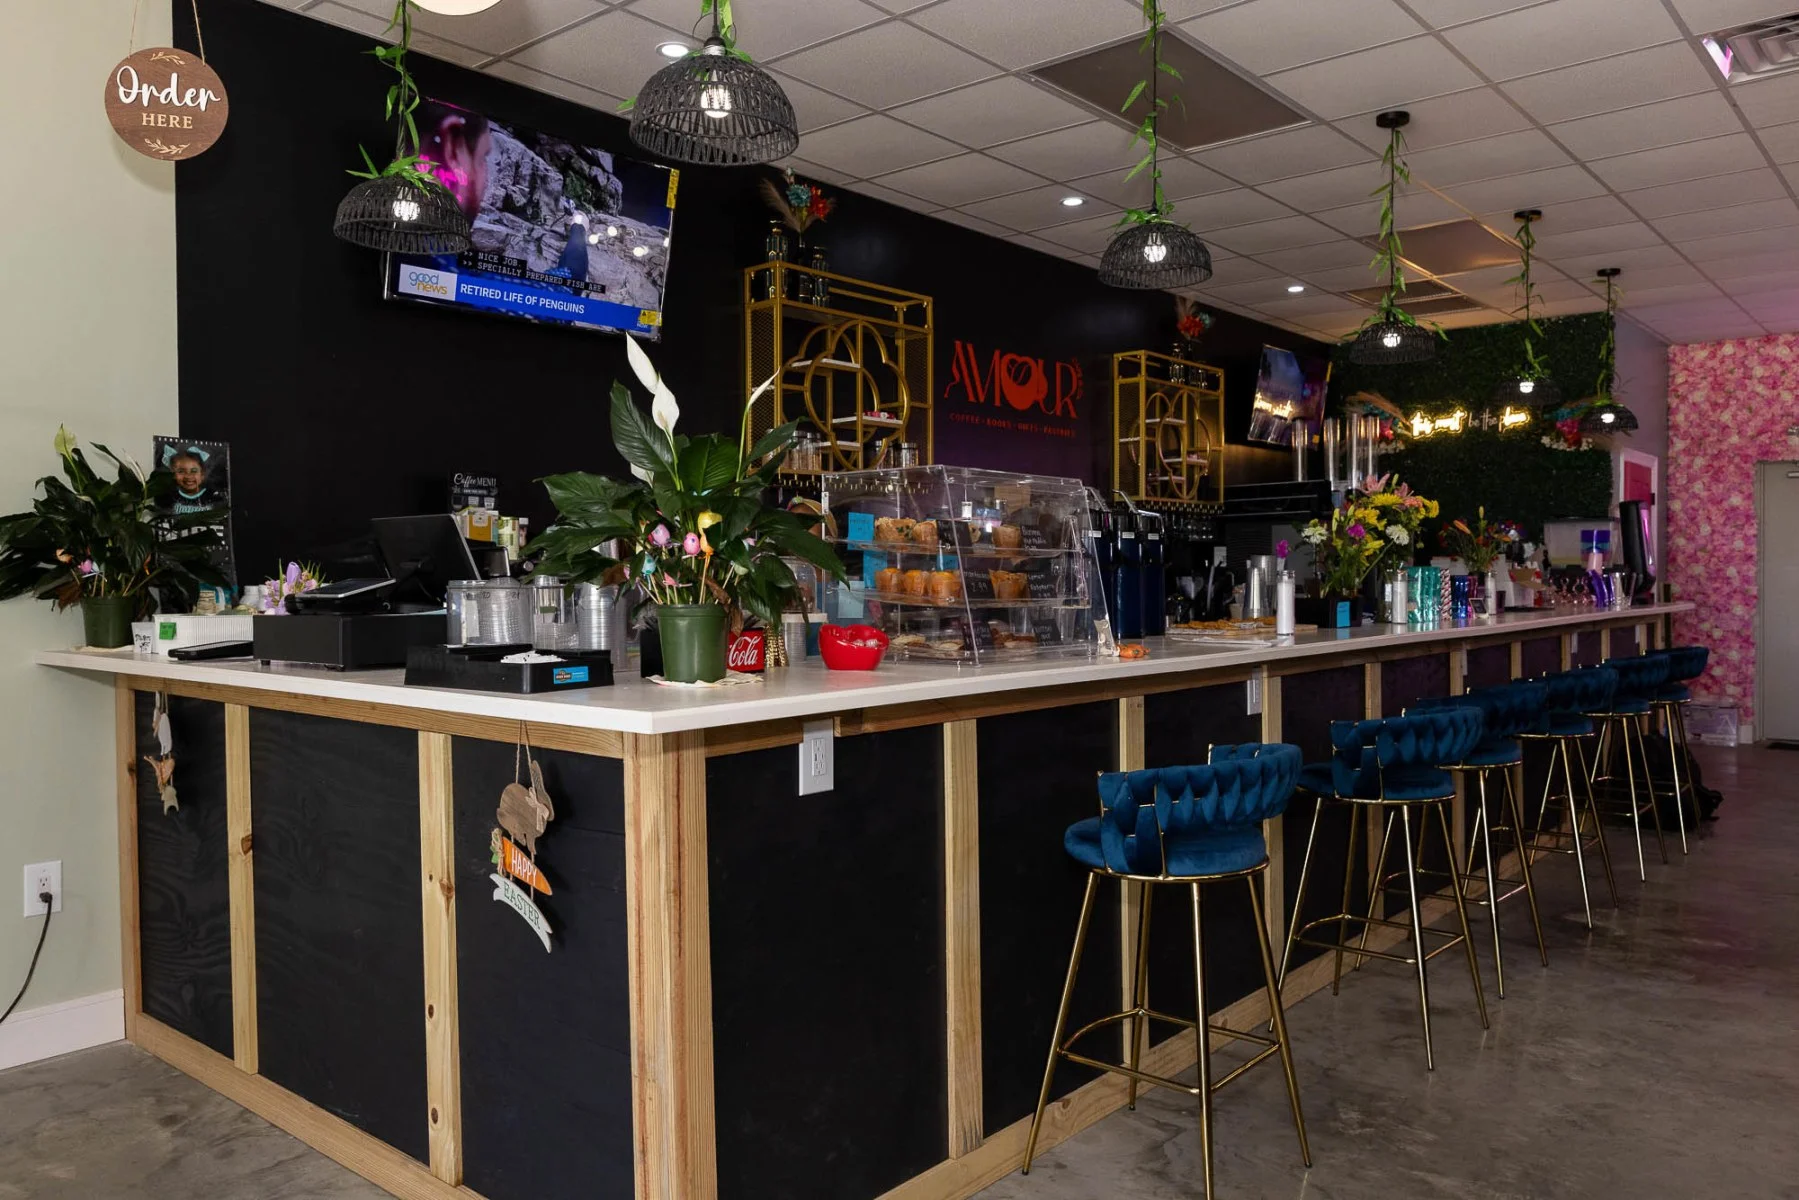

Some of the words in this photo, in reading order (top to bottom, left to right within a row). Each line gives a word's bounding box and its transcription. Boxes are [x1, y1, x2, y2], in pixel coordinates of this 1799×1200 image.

[117, 65, 221, 112] Order
[142, 113, 193, 129] HERE
[478, 252, 499, 263] NICE
[408, 271, 439, 287] good
[416, 281, 448, 295] news
[477, 262, 522, 277] SPECIALLY
[526, 272, 564, 285] PREPARED
[567, 279, 585, 289] FISH
[588, 283, 603, 292] ARE
[460, 283, 501, 299] RETIRED
[503, 291, 524, 304] LIFE
[525, 295, 538, 306] OF
[539, 297, 585, 315] PENGUINS
[944, 340, 1079, 419] AMOUR
[949, 412, 980, 425] COFFEE
[454, 473, 477, 488] Coffee
[477, 477, 497, 487] MENU
[510, 847, 538, 887] HAPPY
[503, 880, 541, 930] EASTER
